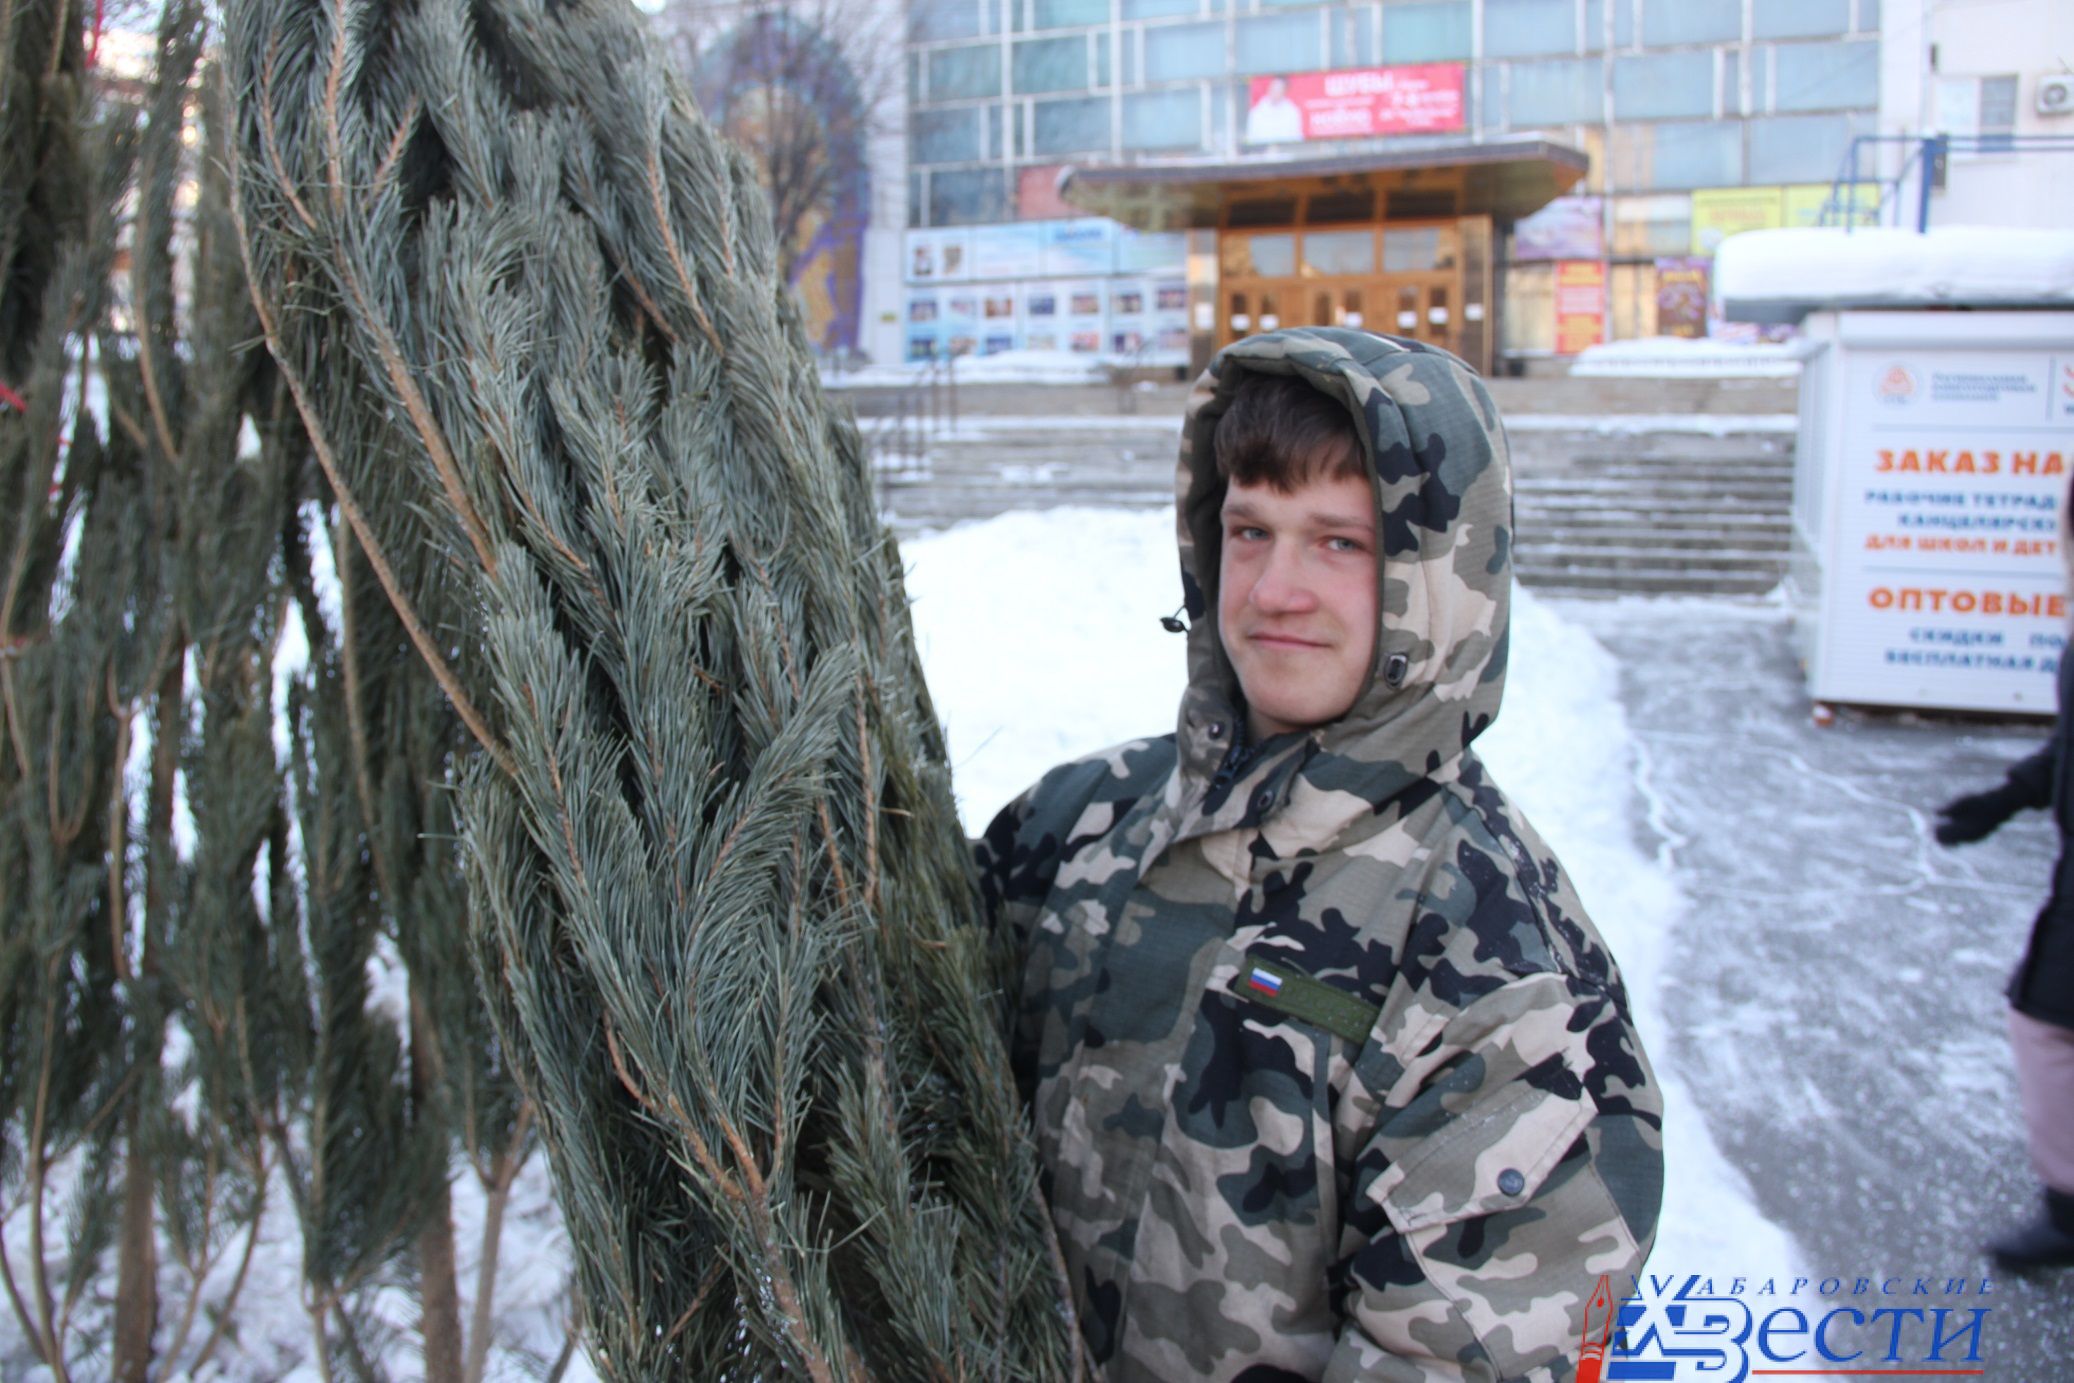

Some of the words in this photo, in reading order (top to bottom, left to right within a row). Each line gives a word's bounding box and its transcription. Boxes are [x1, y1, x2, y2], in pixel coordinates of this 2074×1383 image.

[1875, 450, 2000, 473] ЗАКАЗ
[2012, 451, 2065, 475] НА
[1865, 491, 1965, 505] РАБОЧИЕ
[1865, 535, 1912, 550] ДЛЯ
[1918, 538, 1986, 552] ШКОЛ
[1993, 540, 2009, 553] И
[1868, 587, 2067, 617] ОПТОВЫЕ
[1909, 628, 2003, 646] СКИДКИ
[1886, 650, 2034, 669] БЕСПЛАТНАЯ
